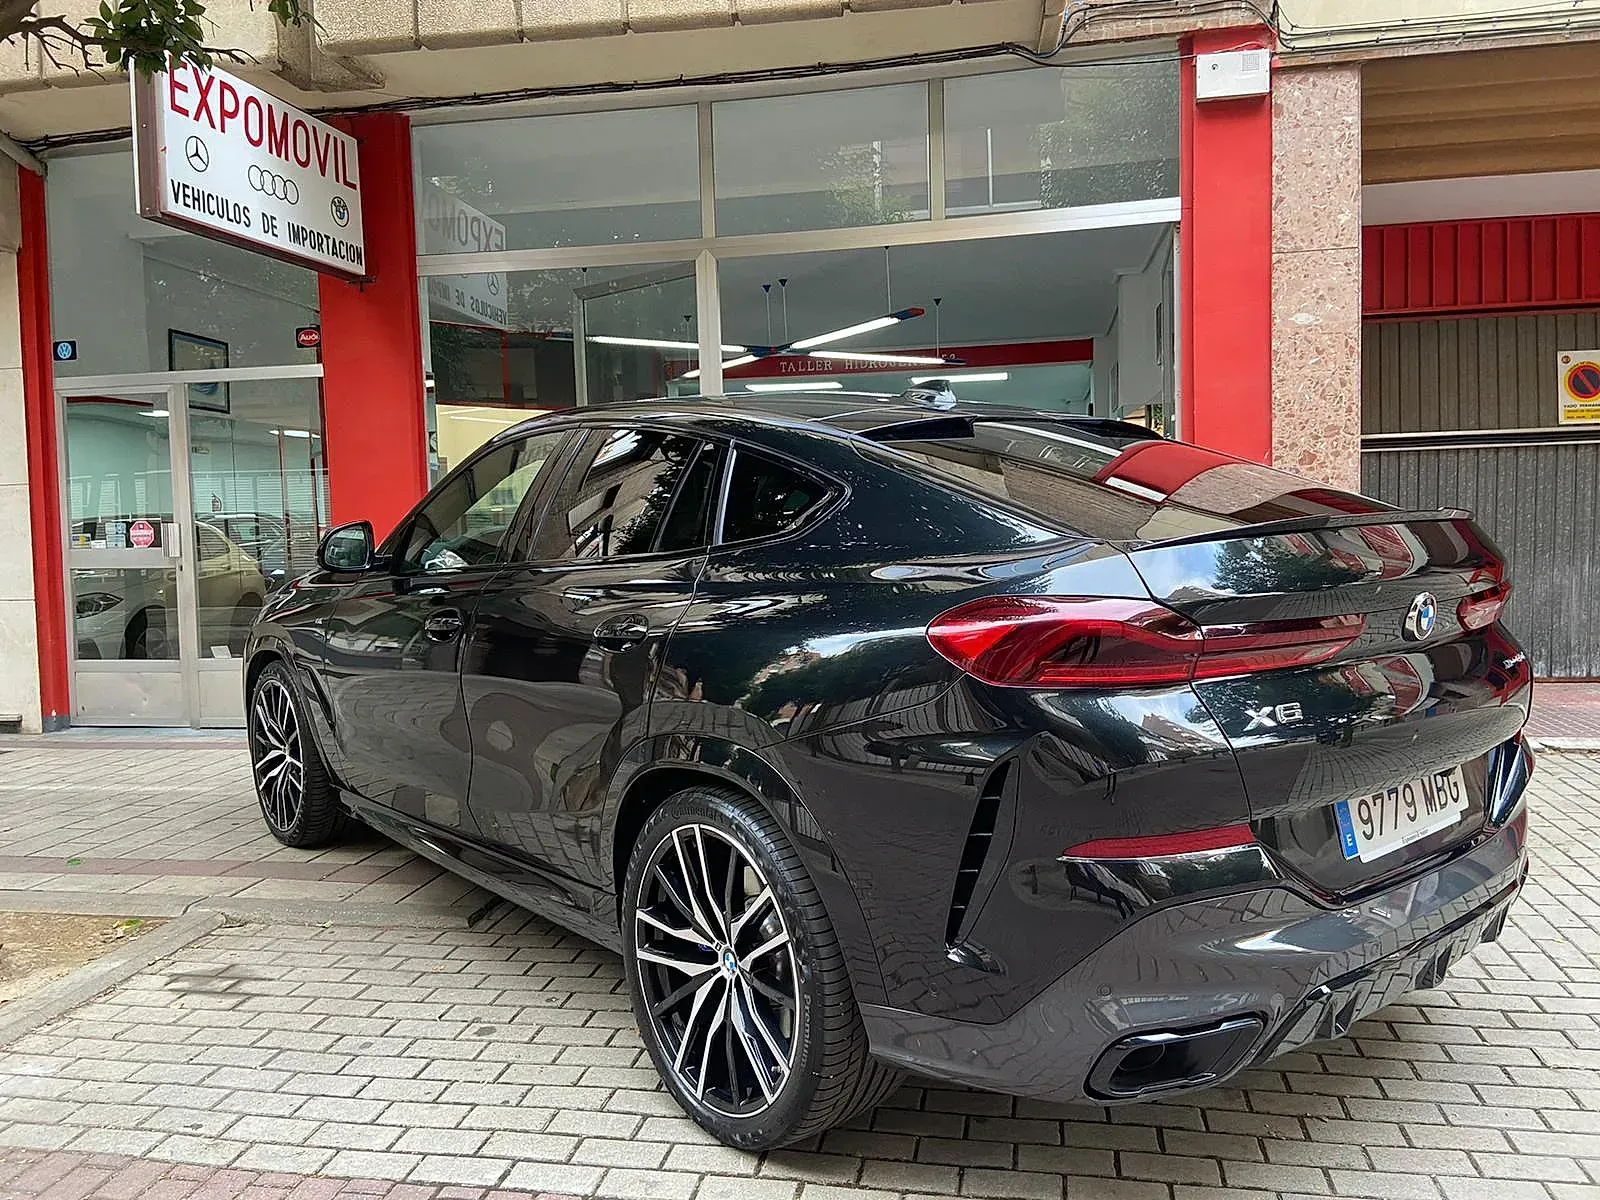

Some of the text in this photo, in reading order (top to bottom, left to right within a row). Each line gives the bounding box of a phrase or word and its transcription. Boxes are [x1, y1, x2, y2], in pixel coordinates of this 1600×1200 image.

[168, 56, 357, 190] EXPOMOVIL
[171, 179, 362, 266] VEHICULOS DE IMPORTACION
[780, 360, 832, 372] TALLER
[1243, 702, 1303, 732] X6
[1357, 772, 1460, 841] 9779 MBG
[1347, 834, 1354, 846] E
